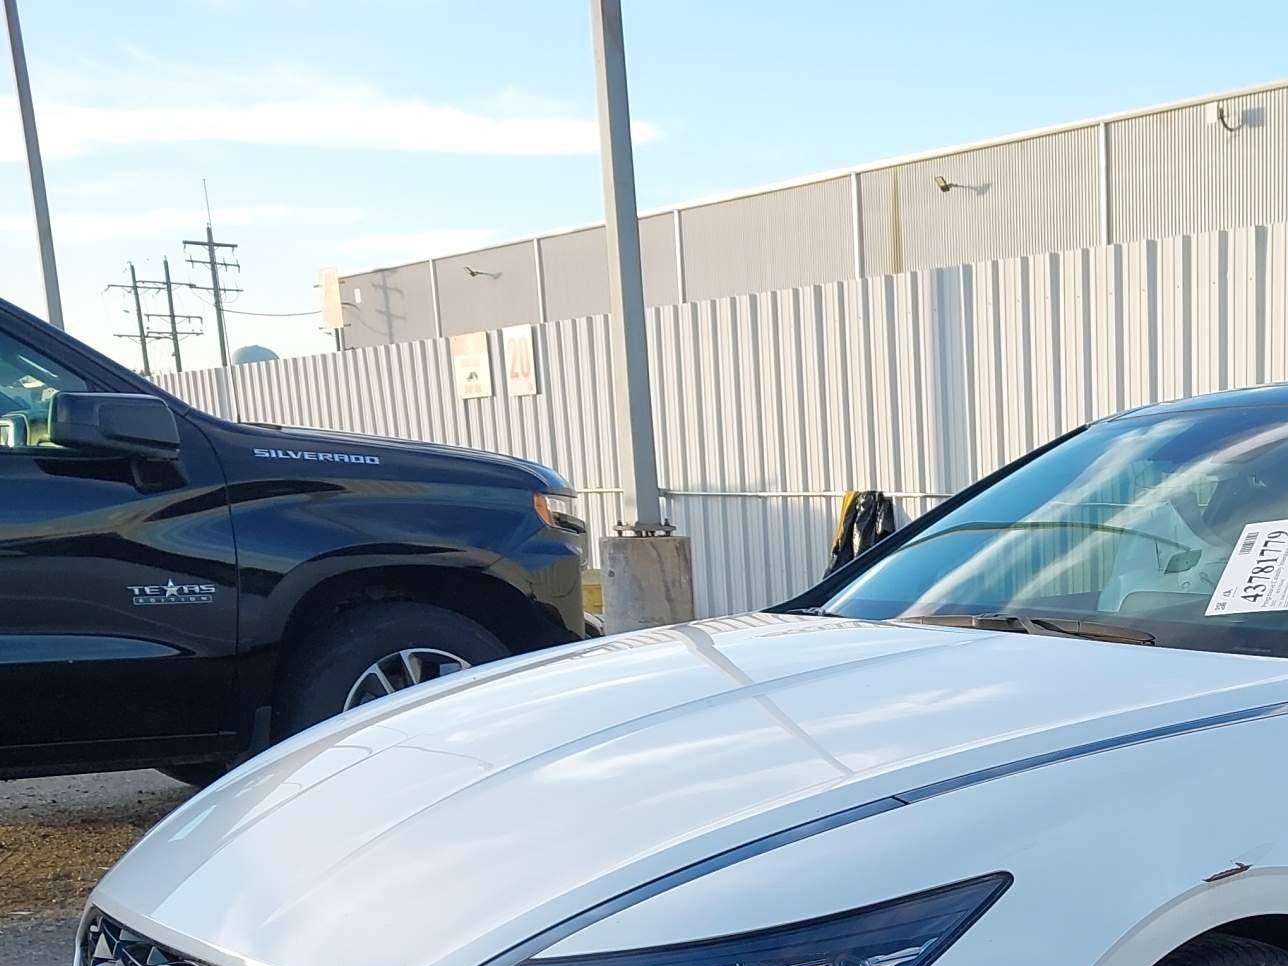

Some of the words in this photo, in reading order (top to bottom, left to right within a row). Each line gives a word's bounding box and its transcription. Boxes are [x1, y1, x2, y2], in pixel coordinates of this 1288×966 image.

[253, 448, 380, 465] SILVERADO
[1240, 530, 1288, 603] 43781779
[127, 578, 215, 597] TEXAS
